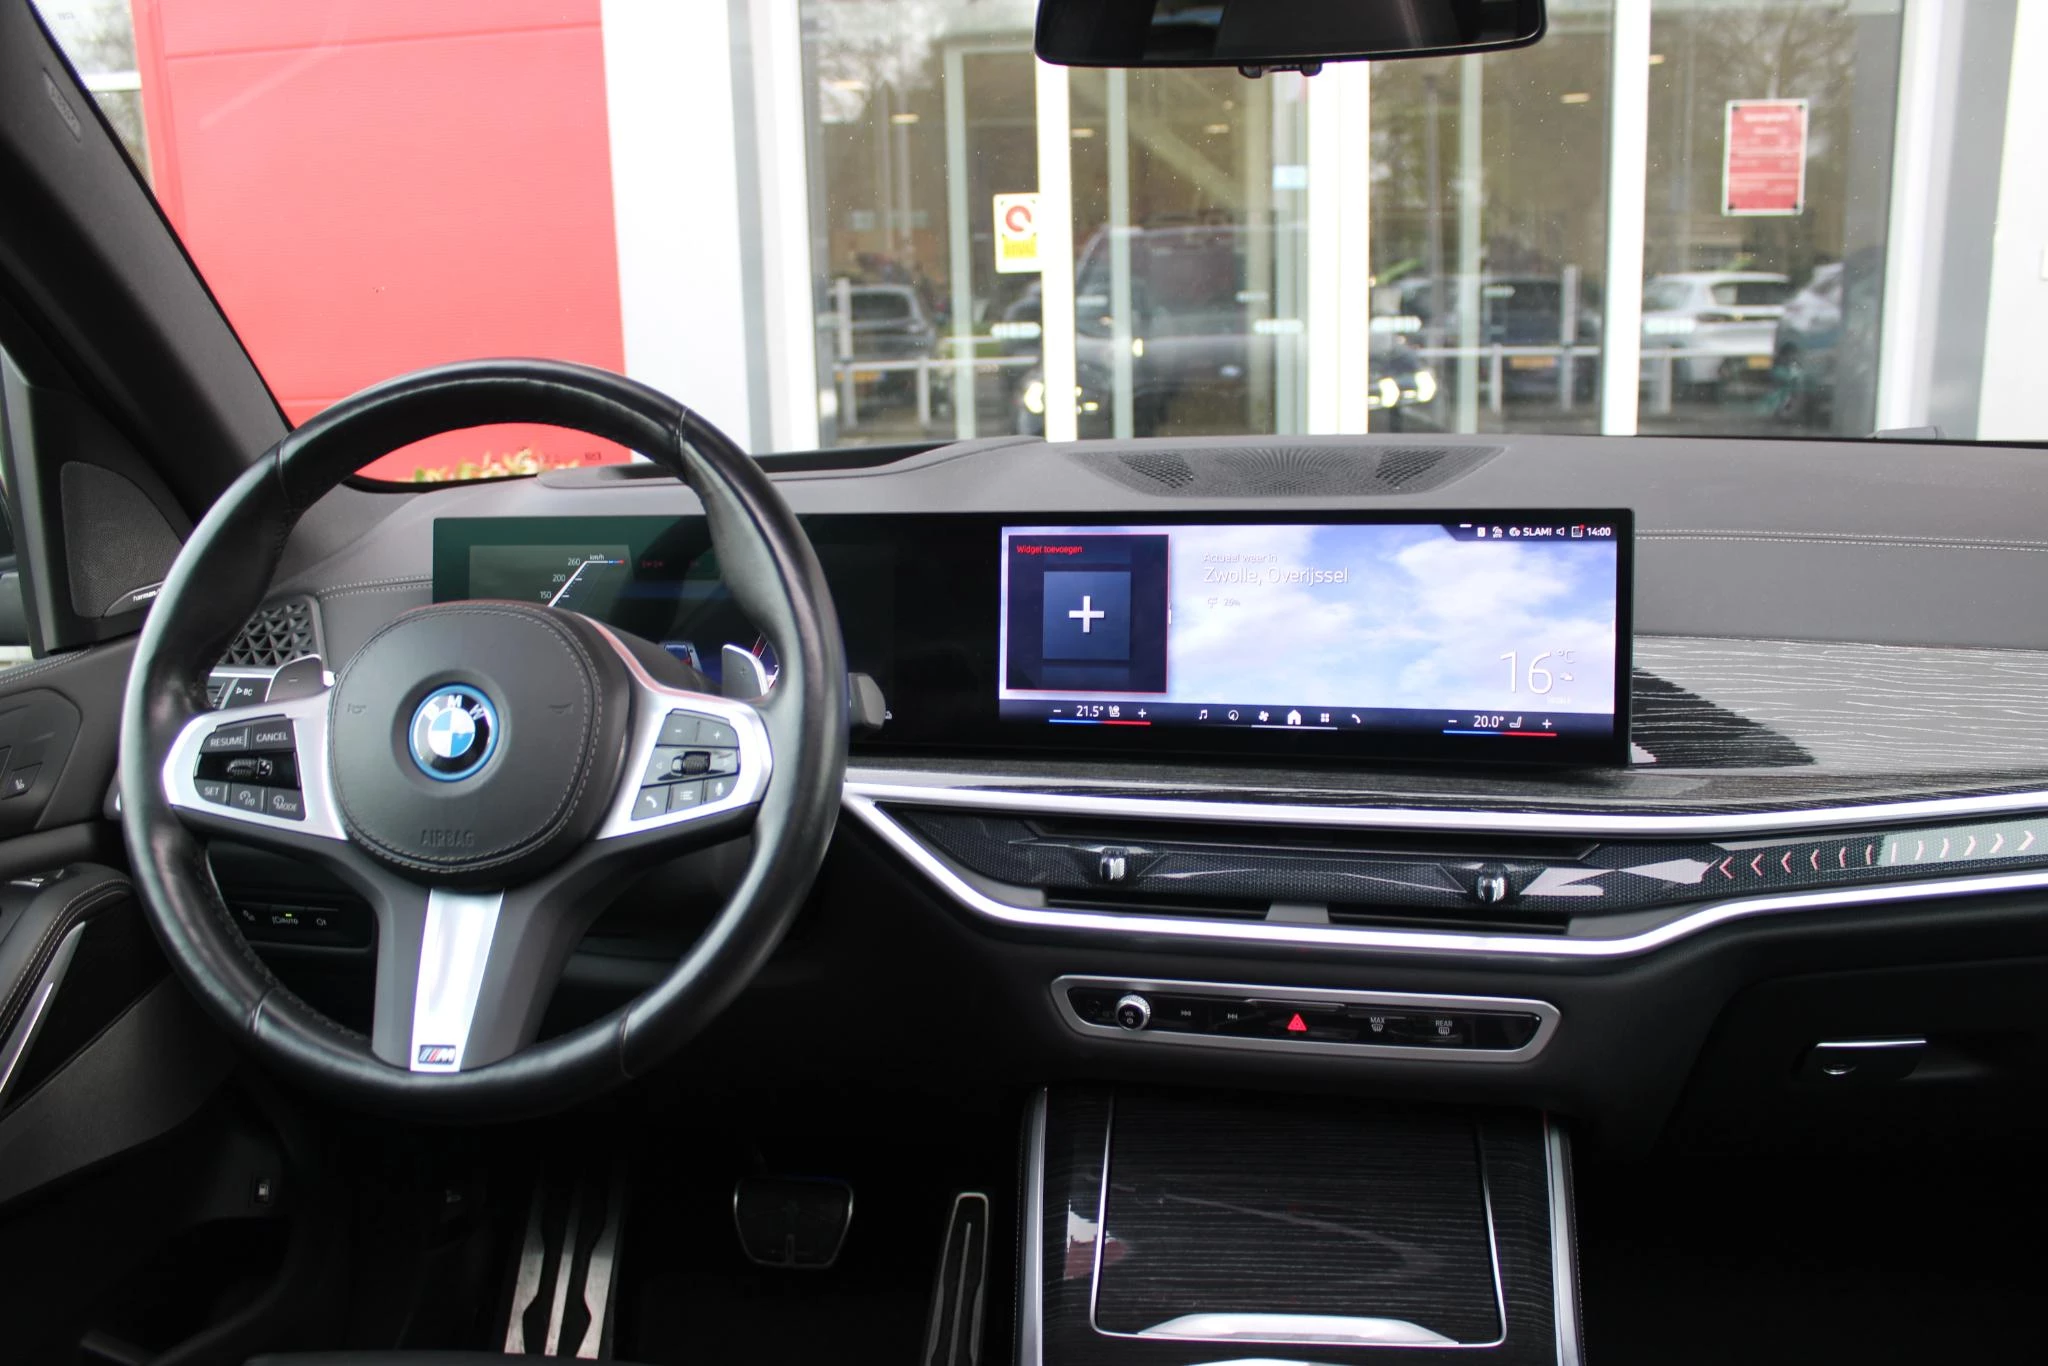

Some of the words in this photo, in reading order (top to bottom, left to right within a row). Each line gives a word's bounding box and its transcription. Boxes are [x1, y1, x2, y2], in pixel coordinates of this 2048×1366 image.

[1522, 527, 1552, 537] SLAM!
[1586, 527, 1612, 537] 14:00
[1016, 544, 1042, 555] Widget
[1044, 545, 1083, 556] toevoegen
[567, 557, 581, 566] 260
[589, 553, 605, 561] km/h
[552, 574, 566, 583] 200
[1203, 567, 1263, 586] Zwolle,
[1267, 567, 1349, 586] Overijssel
[540, 591, 552, 600] 150
[1500, 650, 1554, 695] 16
[423, 694, 485, 721] BMW
[210, 735, 244, 747] RESUME
[256, 731, 288, 743] CANCEL
[204, 786, 220, 797] SET
[275, 802, 298, 812] MODE
[420, 829, 475, 848] AIRBAG
[1370, 1016, 1386, 1024] MAX
[1435, 1019, 1453, 1027] REAR
